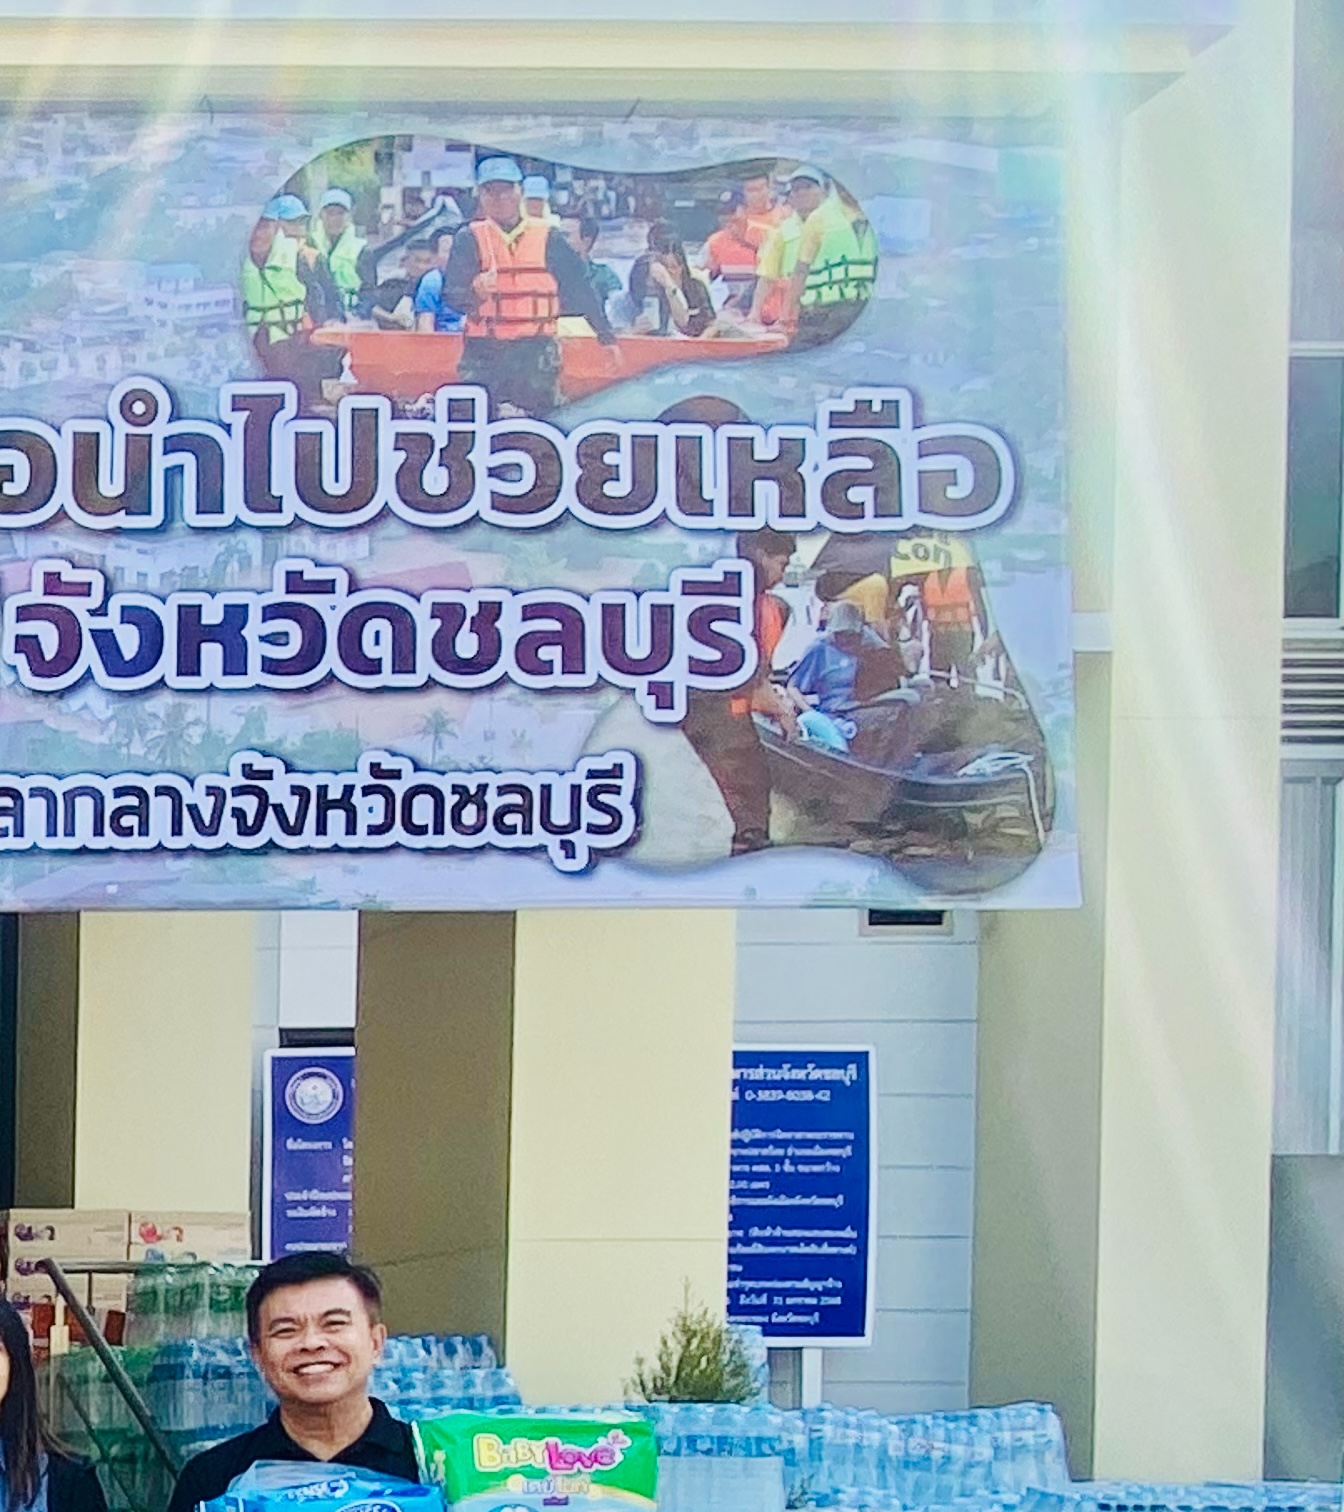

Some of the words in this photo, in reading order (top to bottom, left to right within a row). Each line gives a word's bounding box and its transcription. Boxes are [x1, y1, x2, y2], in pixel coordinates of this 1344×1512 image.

[15, 568, 752, 713] จังหวัดชลบุรี
